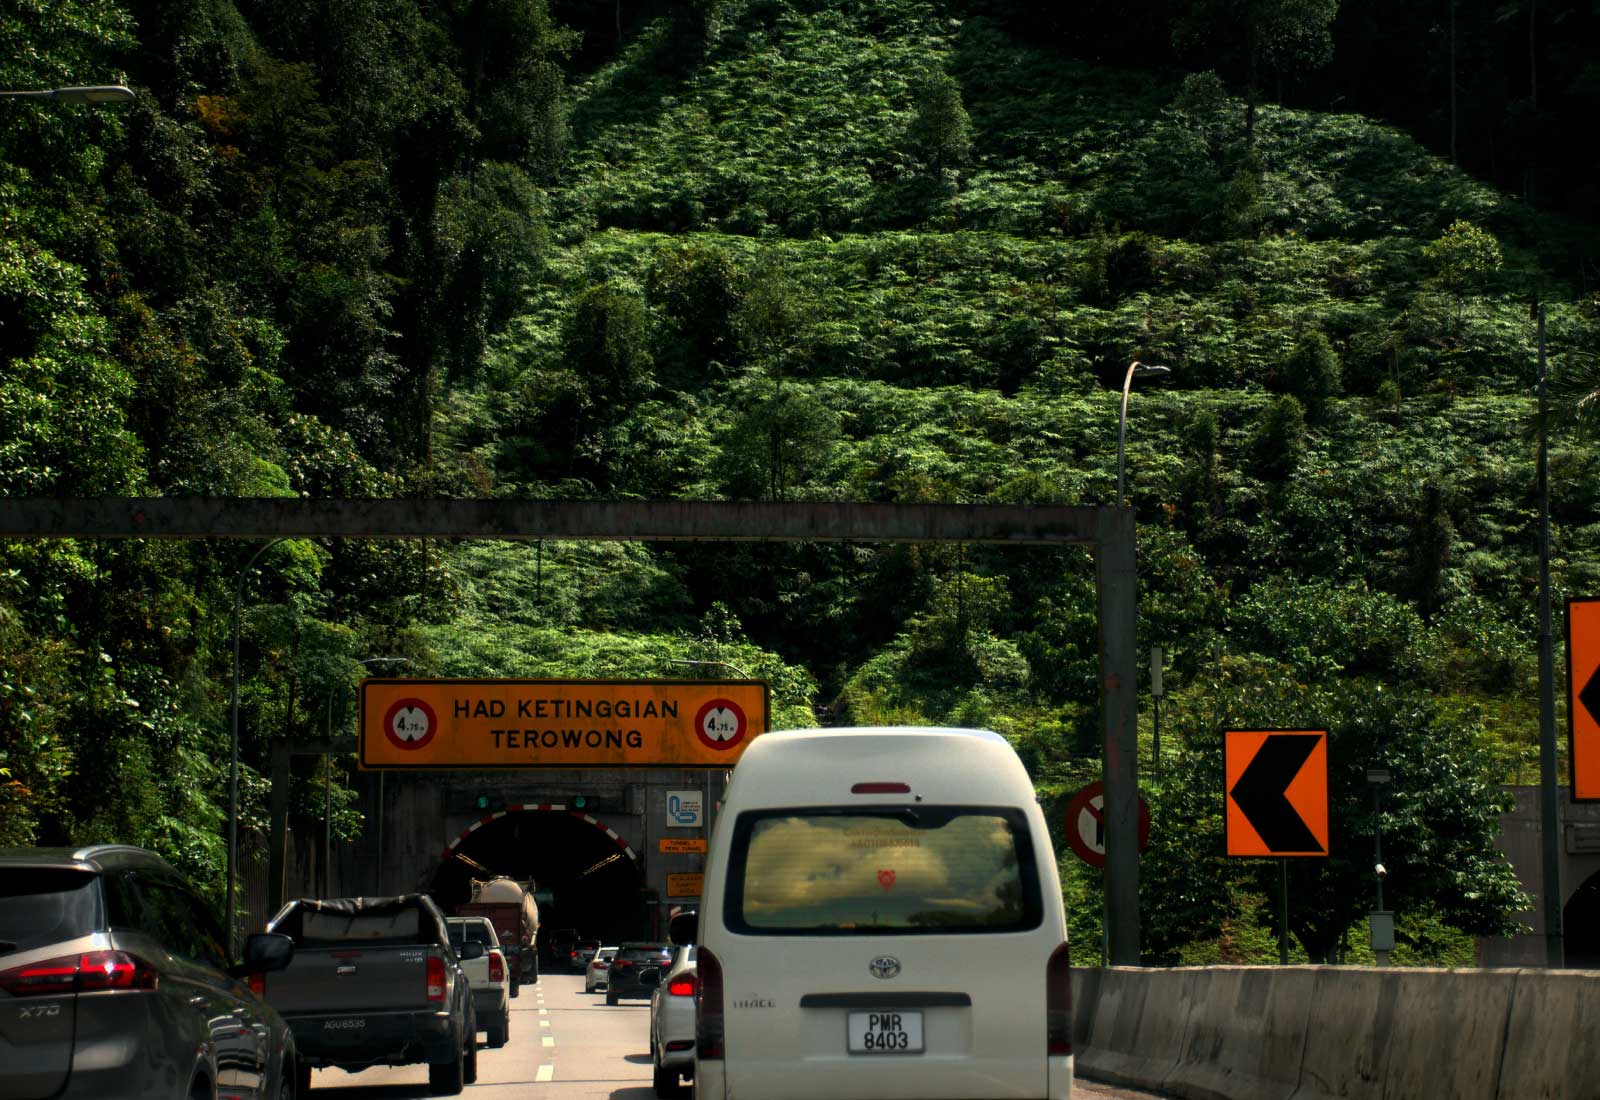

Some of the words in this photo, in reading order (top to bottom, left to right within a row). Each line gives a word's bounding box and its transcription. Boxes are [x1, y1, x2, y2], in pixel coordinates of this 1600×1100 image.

[454, 699, 506, 719] HAD
[517, 699, 679, 719] KETINGGIAN
[490, 729, 643, 749] TEROWONG
[19, 1004, 61, 1019] X70
[869, 1014, 902, 1031] PMR
[864, 1031, 908, 1049] 8403
